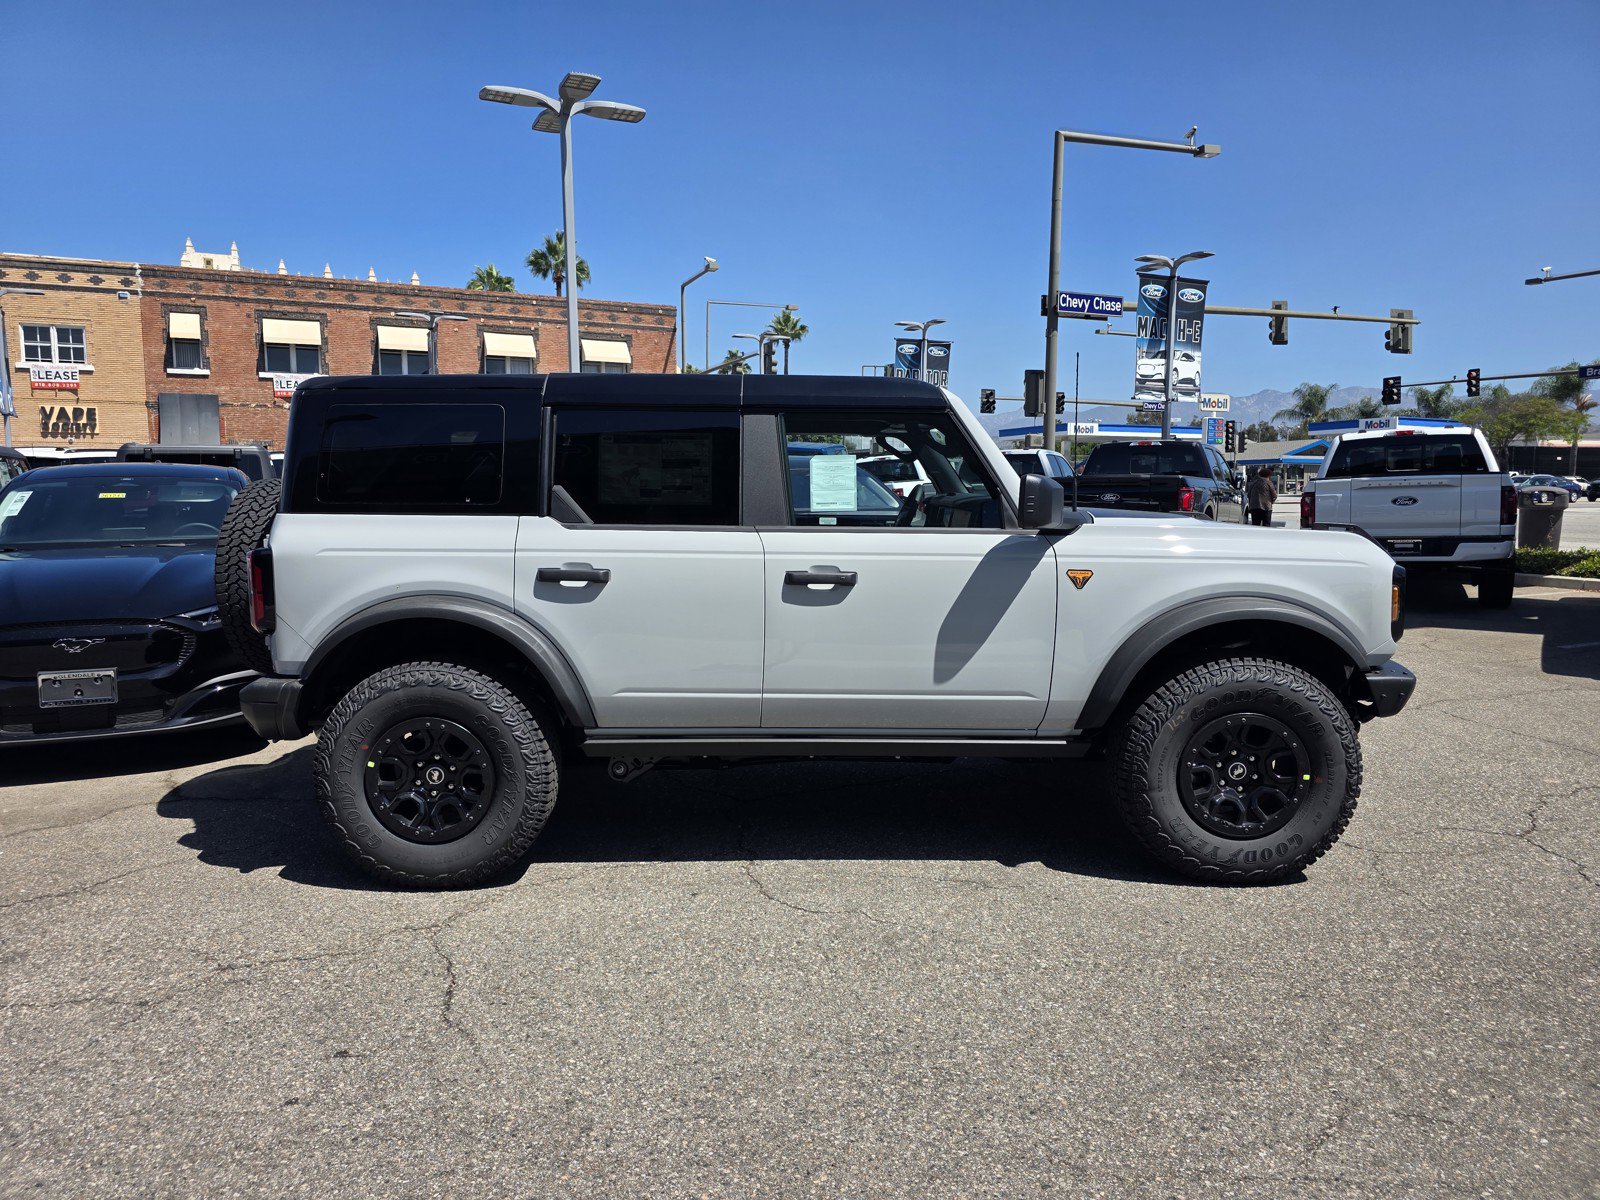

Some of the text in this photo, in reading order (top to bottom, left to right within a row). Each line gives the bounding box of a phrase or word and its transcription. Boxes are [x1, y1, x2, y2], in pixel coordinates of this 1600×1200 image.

[1145, 286, 1164, 297] Ford
[1182, 290, 1200, 301] Ford
[1060, 294, 1122, 312] Chevy Chase
[1138, 316, 1168, 340] MAC
[1177, 318, 1201, 343] H-E
[38, 370, 78, 380] LEASE
[280, 380, 299, 389] LEA
[1144, 402, 1156, 410] Chevy
[1203, 398, 1228, 409] Mobil
[40, 406, 96, 424] VAPE
[1074, 425, 1094, 434] Mobil
[1365, 419, 1390, 429] Mobil
[334, 717, 382, 849] GOODYEAR
[474, 713, 520, 846] GOODYEAR
[1169, 816, 1304, 866] GOODYEAR
